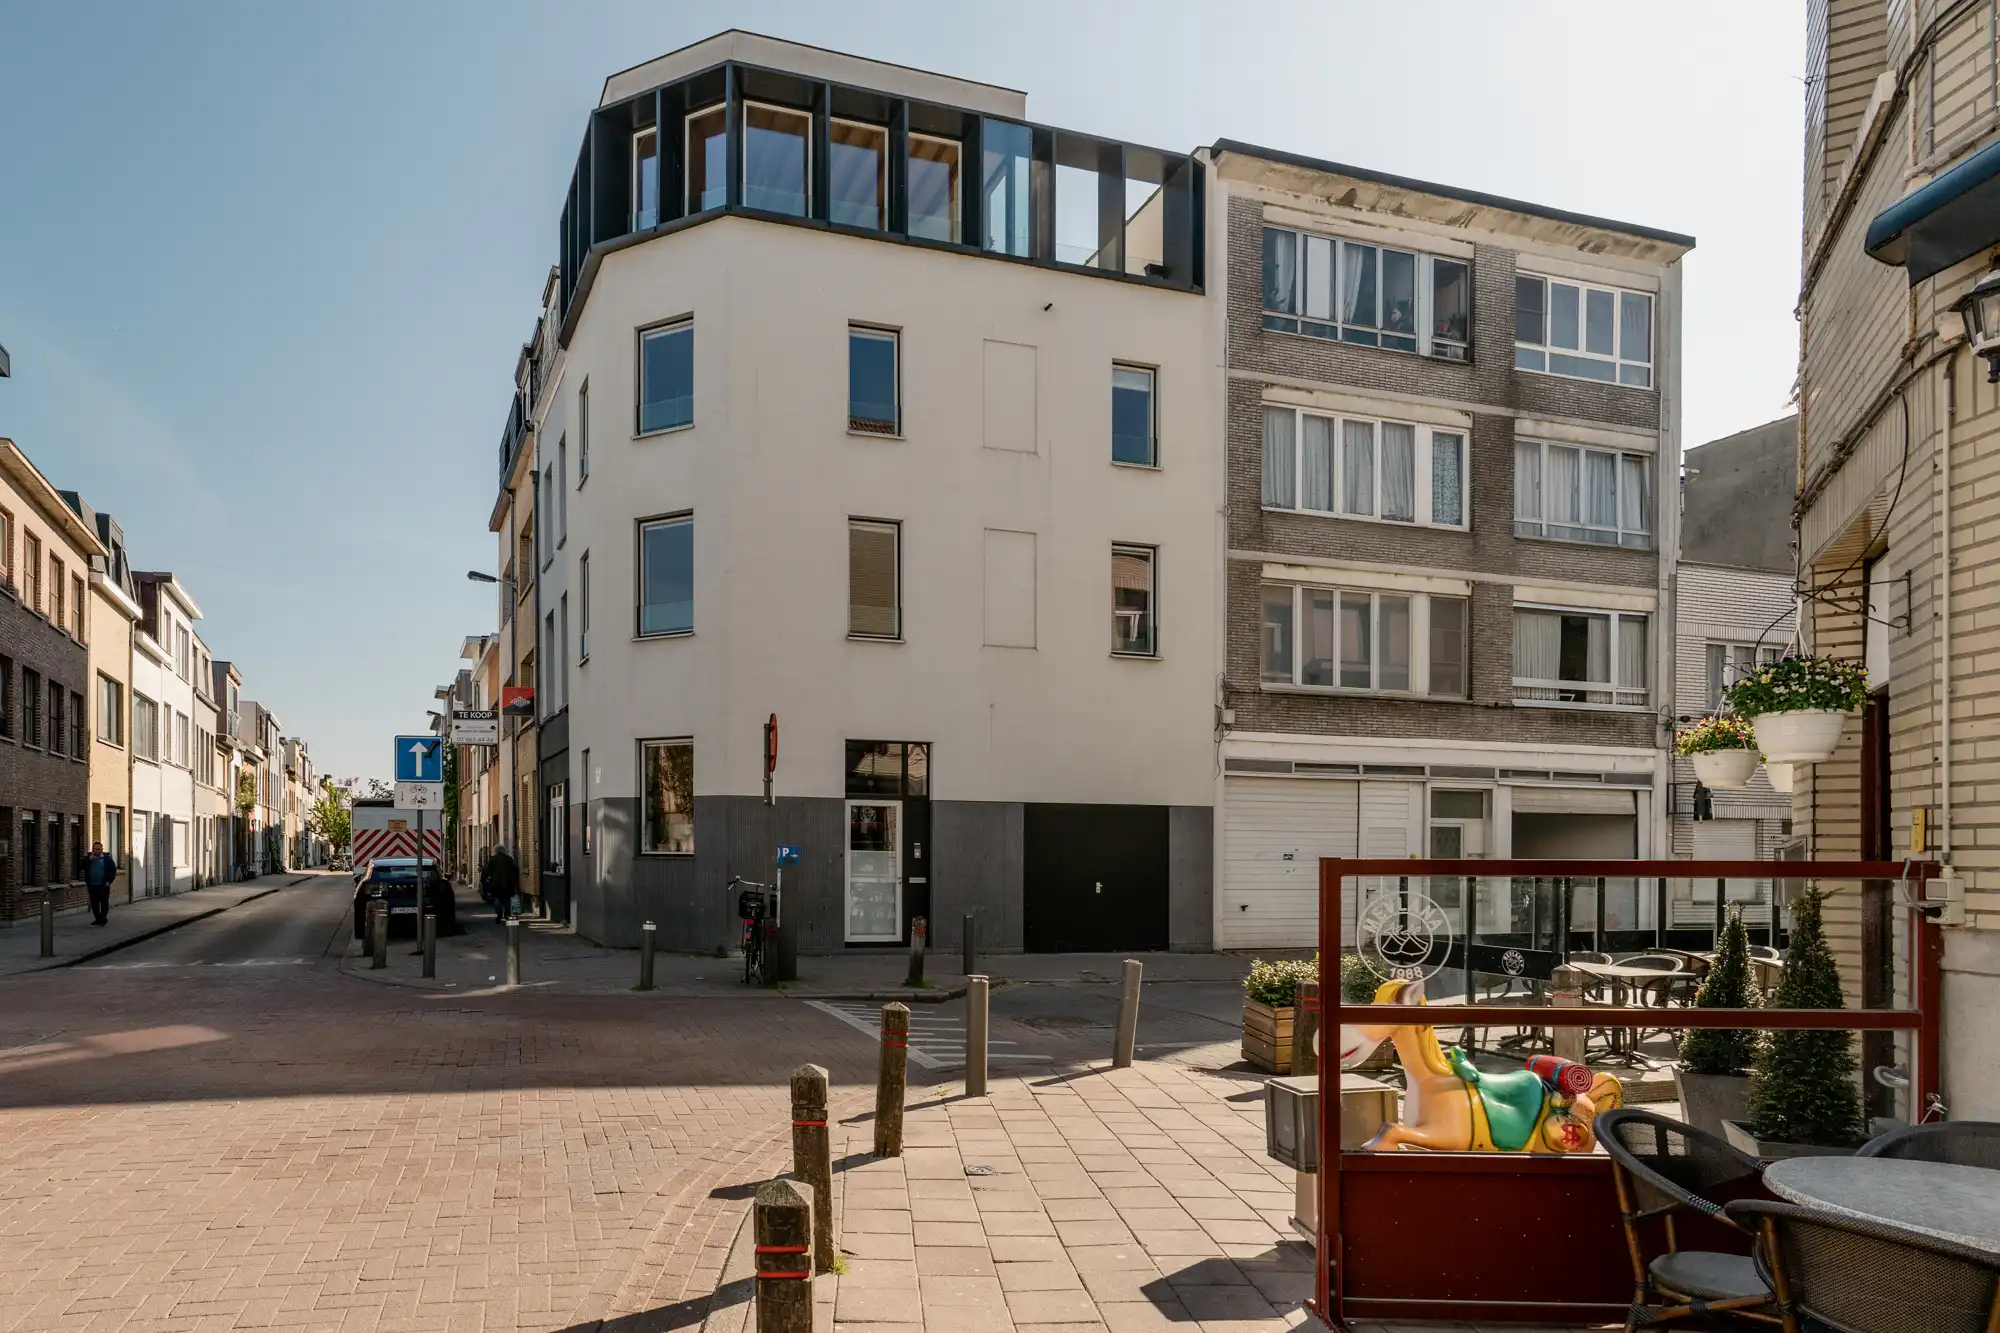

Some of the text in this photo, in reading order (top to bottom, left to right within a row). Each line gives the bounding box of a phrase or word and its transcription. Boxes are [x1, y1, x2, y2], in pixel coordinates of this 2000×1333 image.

[458, 711, 493, 719] TE KOOP
[782, 847, 790, 856] P
[1362, 896, 1443, 934] MEVLANA
[1390, 966, 1423, 979] 1988
